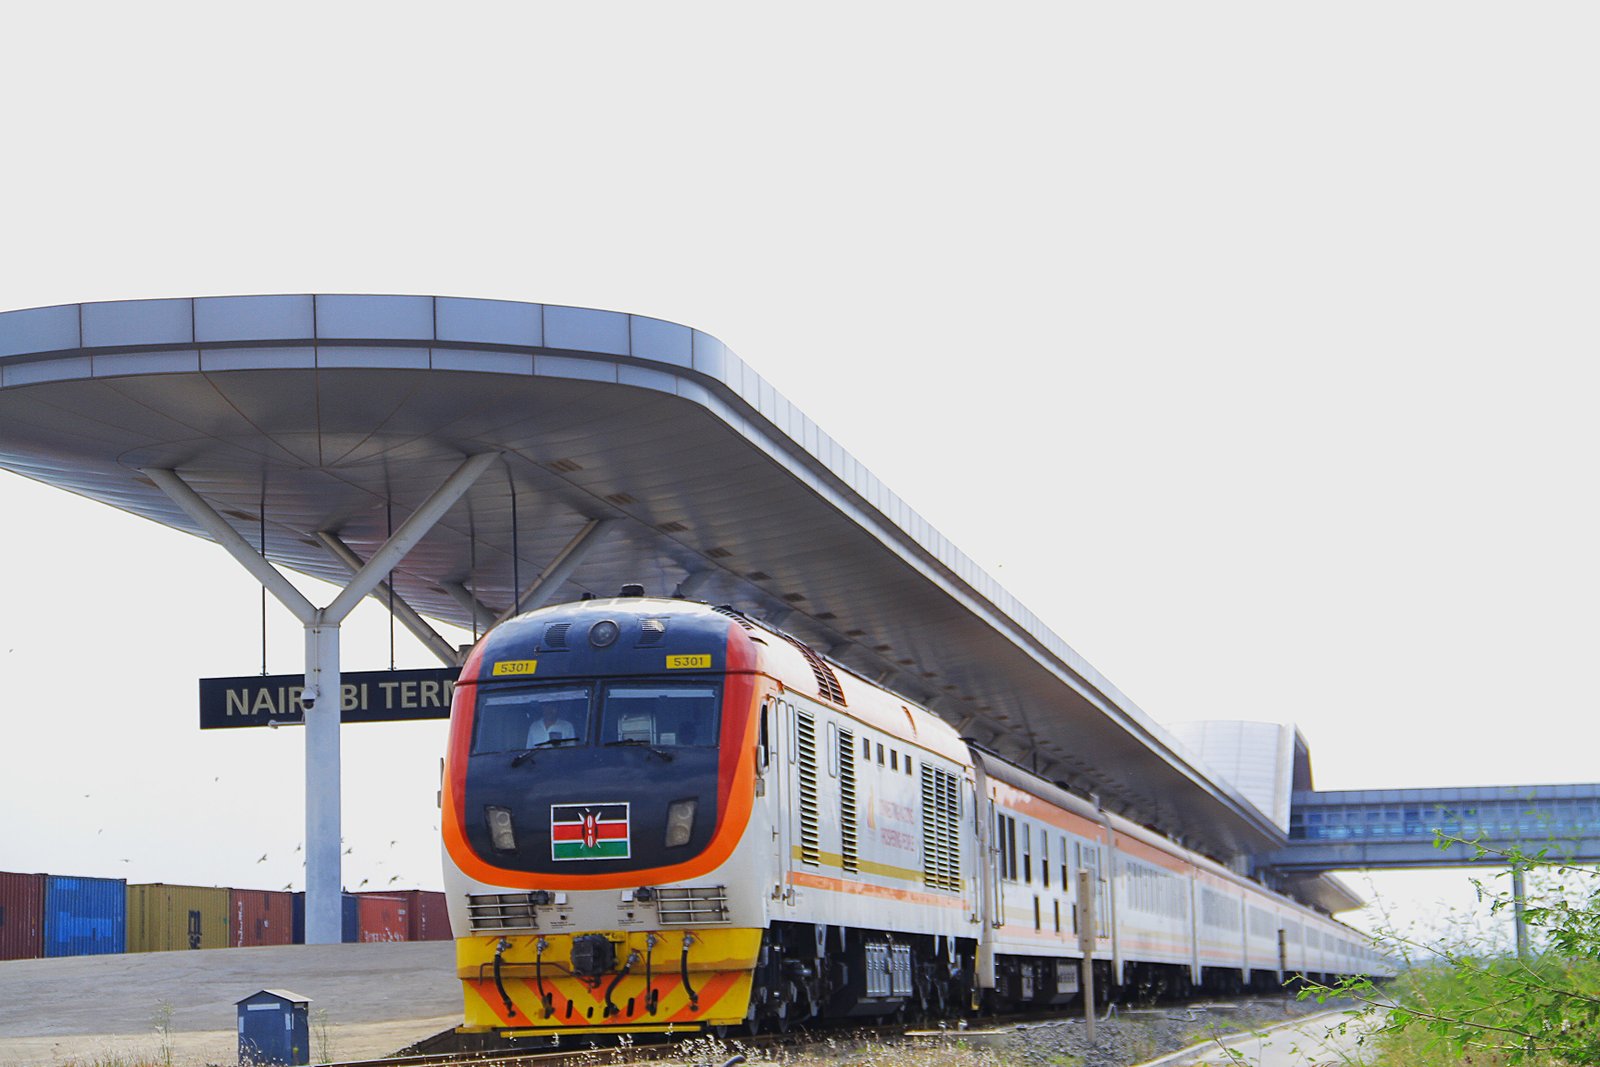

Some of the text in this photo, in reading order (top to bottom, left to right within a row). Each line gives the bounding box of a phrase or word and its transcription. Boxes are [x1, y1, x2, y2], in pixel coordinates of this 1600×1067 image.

[674, 656, 703, 667] 5301
[500, 662, 529, 674] 5301
[226, 683, 368, 716] NAIRBI
